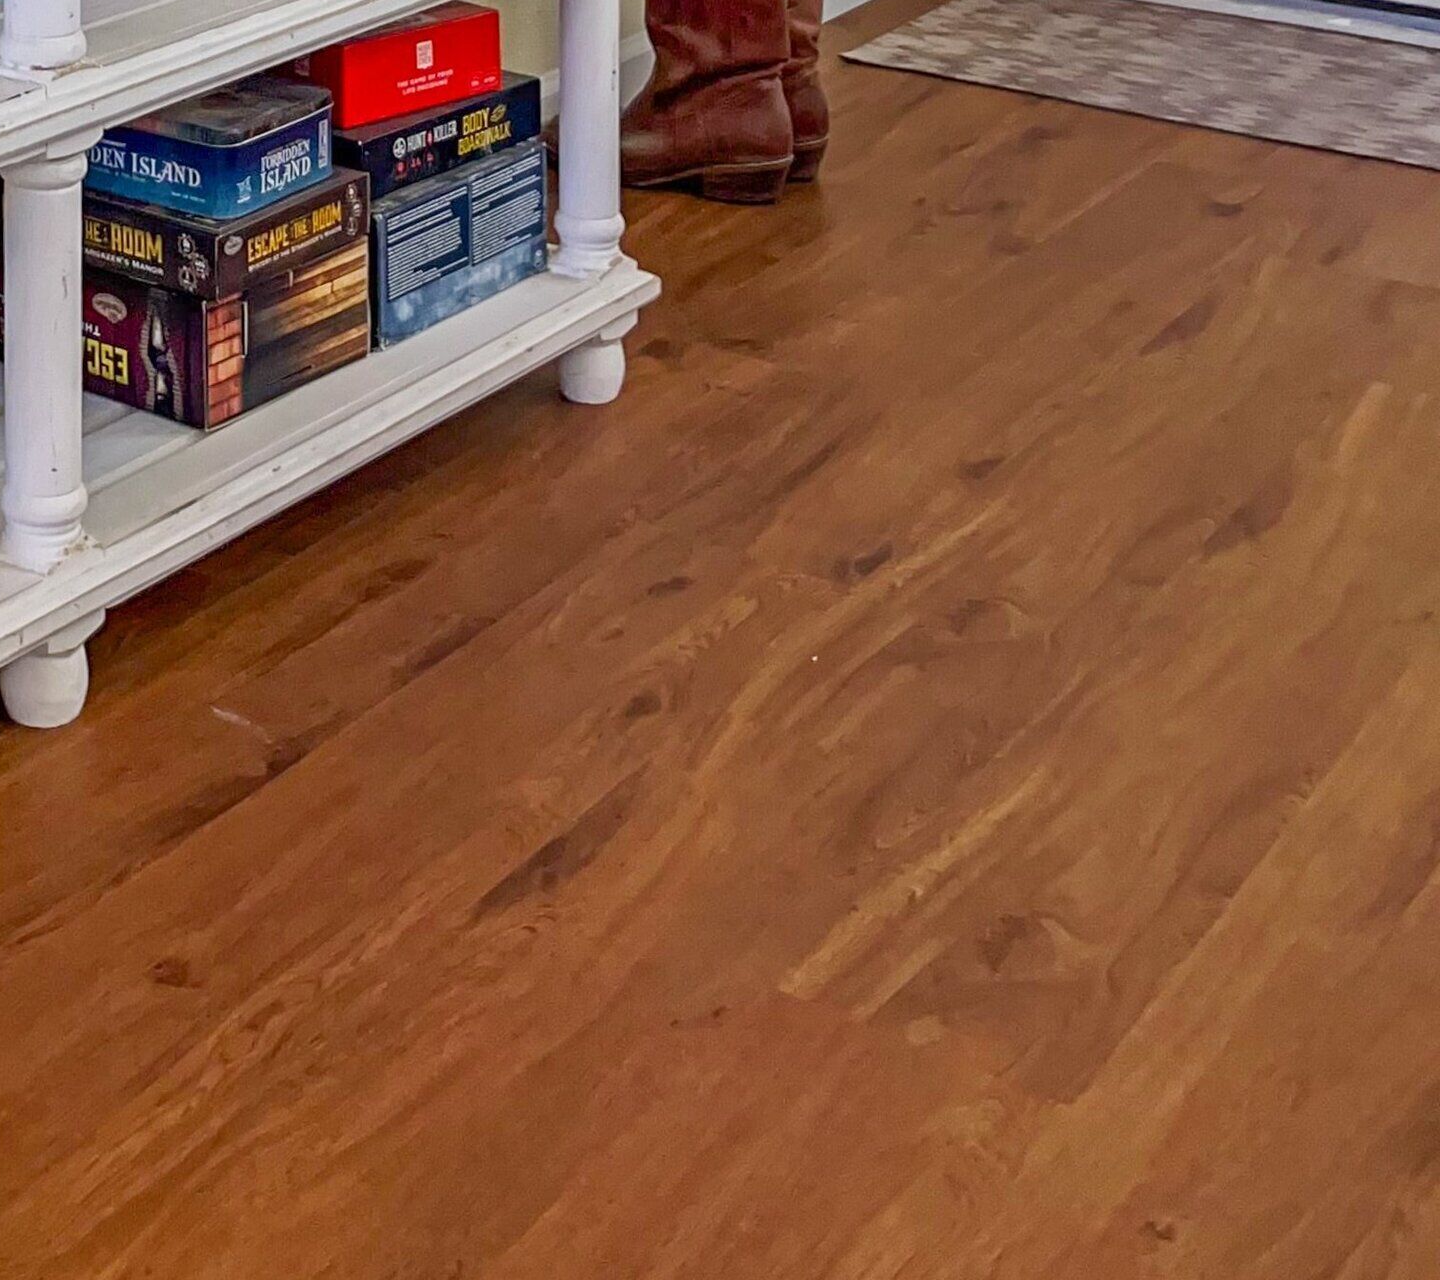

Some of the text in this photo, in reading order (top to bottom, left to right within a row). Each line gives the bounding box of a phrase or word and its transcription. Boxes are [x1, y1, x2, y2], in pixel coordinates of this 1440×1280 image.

[433, 120, 458, 142] KILLER
[458, 120, 512, 155] BOARDWALK
[462, 106, 490, 136] BODY
[130, 151, 202, 187] ISLAND
[260, 156, 312, 194] ISLAND
[85, 220, 163, 264] HE ROOM
[247, 223, 290, 264] ESCAPE
[312, 200, 342, 234] ROOM
[84, 322, 101, 337] TH
[86, 337, 129, 386] ESC
